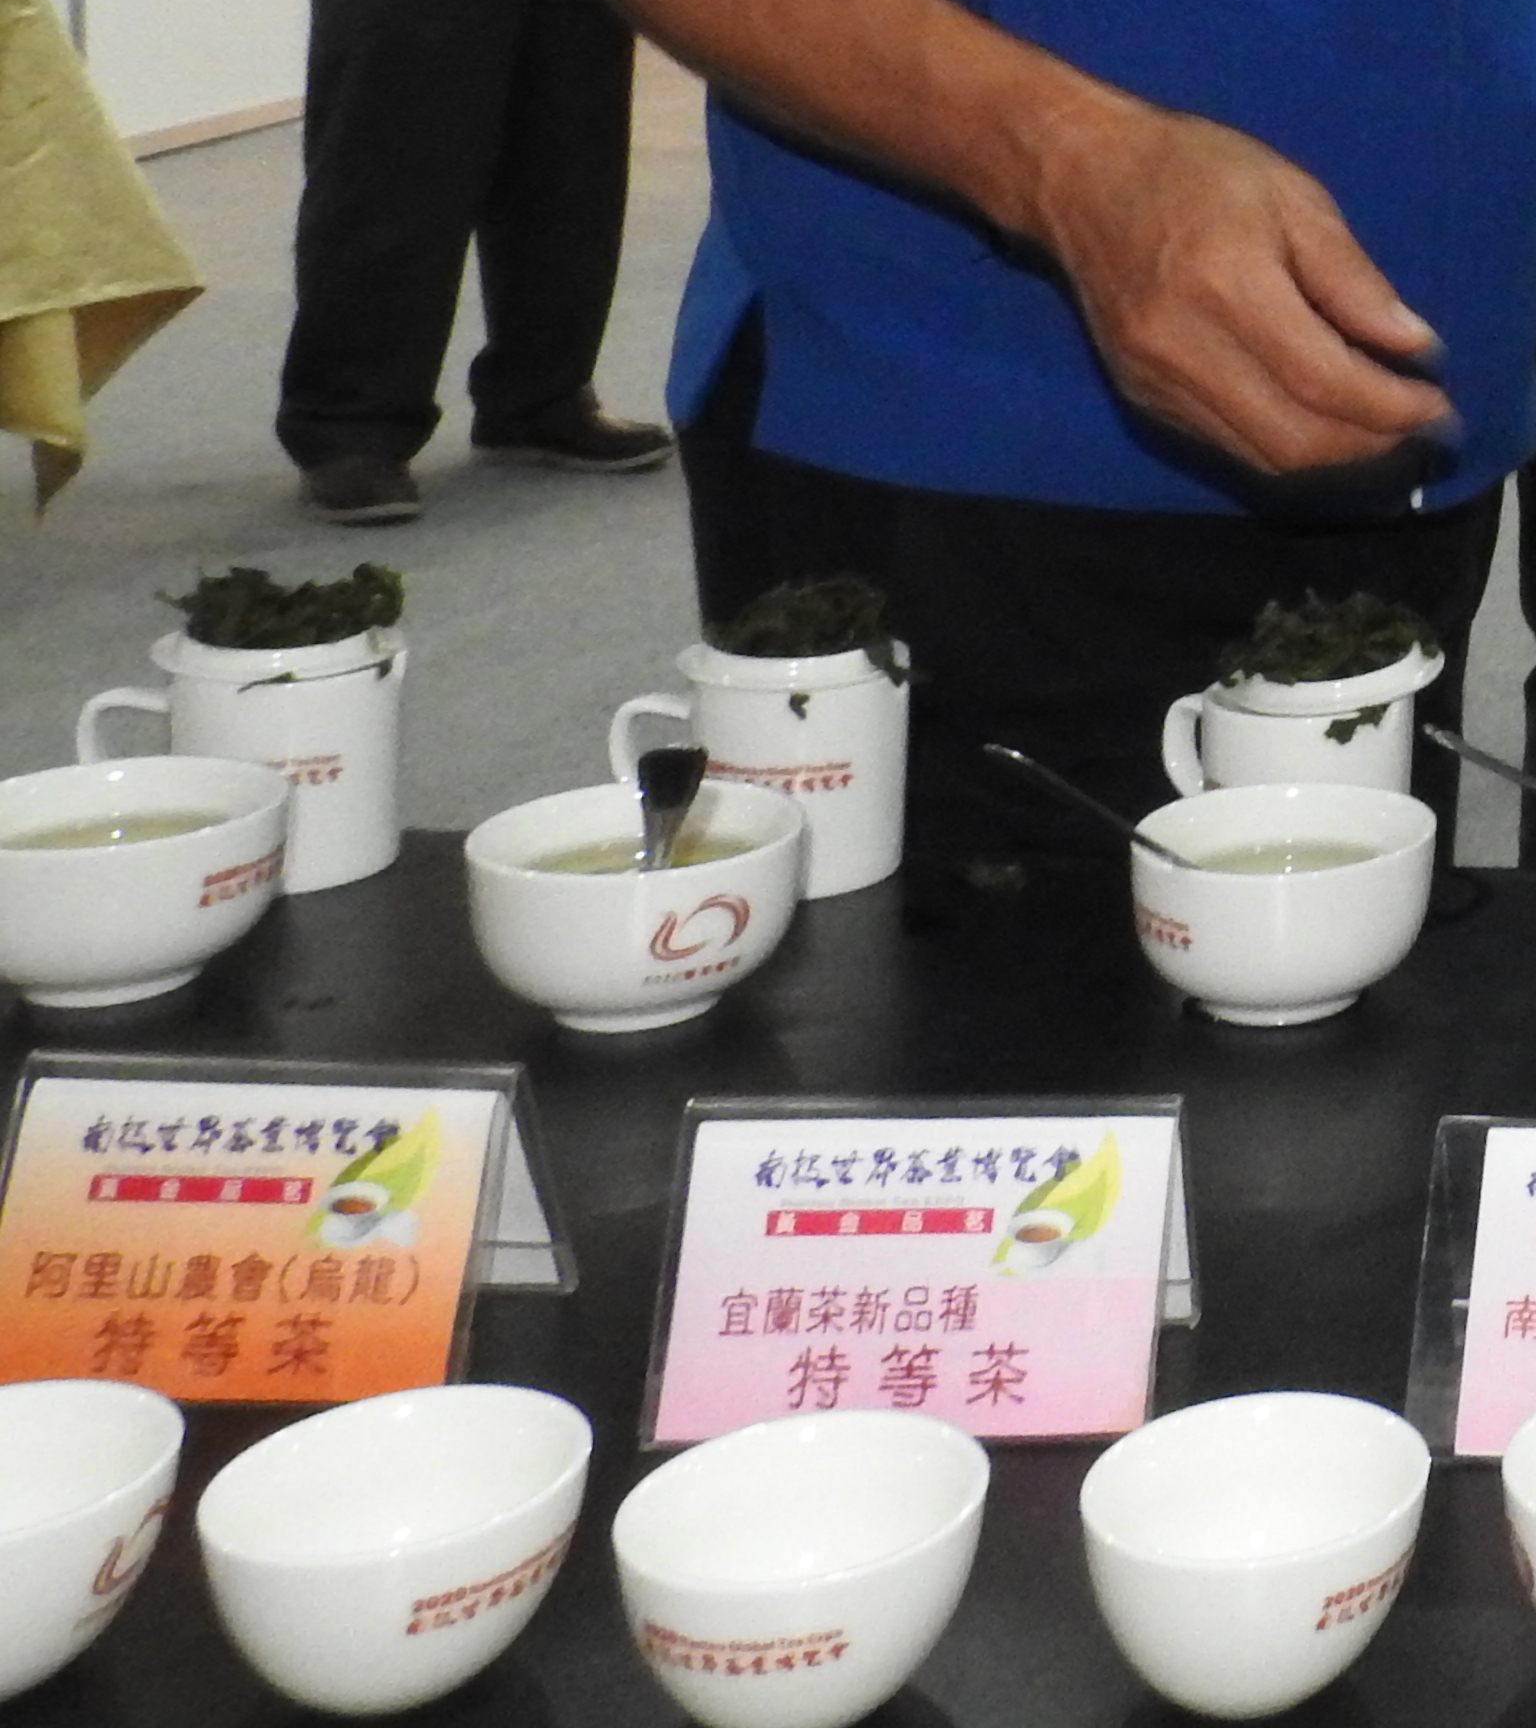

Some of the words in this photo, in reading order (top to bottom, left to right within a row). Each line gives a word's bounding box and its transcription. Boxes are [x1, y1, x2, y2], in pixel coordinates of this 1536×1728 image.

[93, 1310, 332, 1376] 特等茶
[719, 1284, 980, 1336] 宜蘭茶新品種
[787, 1340, 1030, 1410] 特等茶
